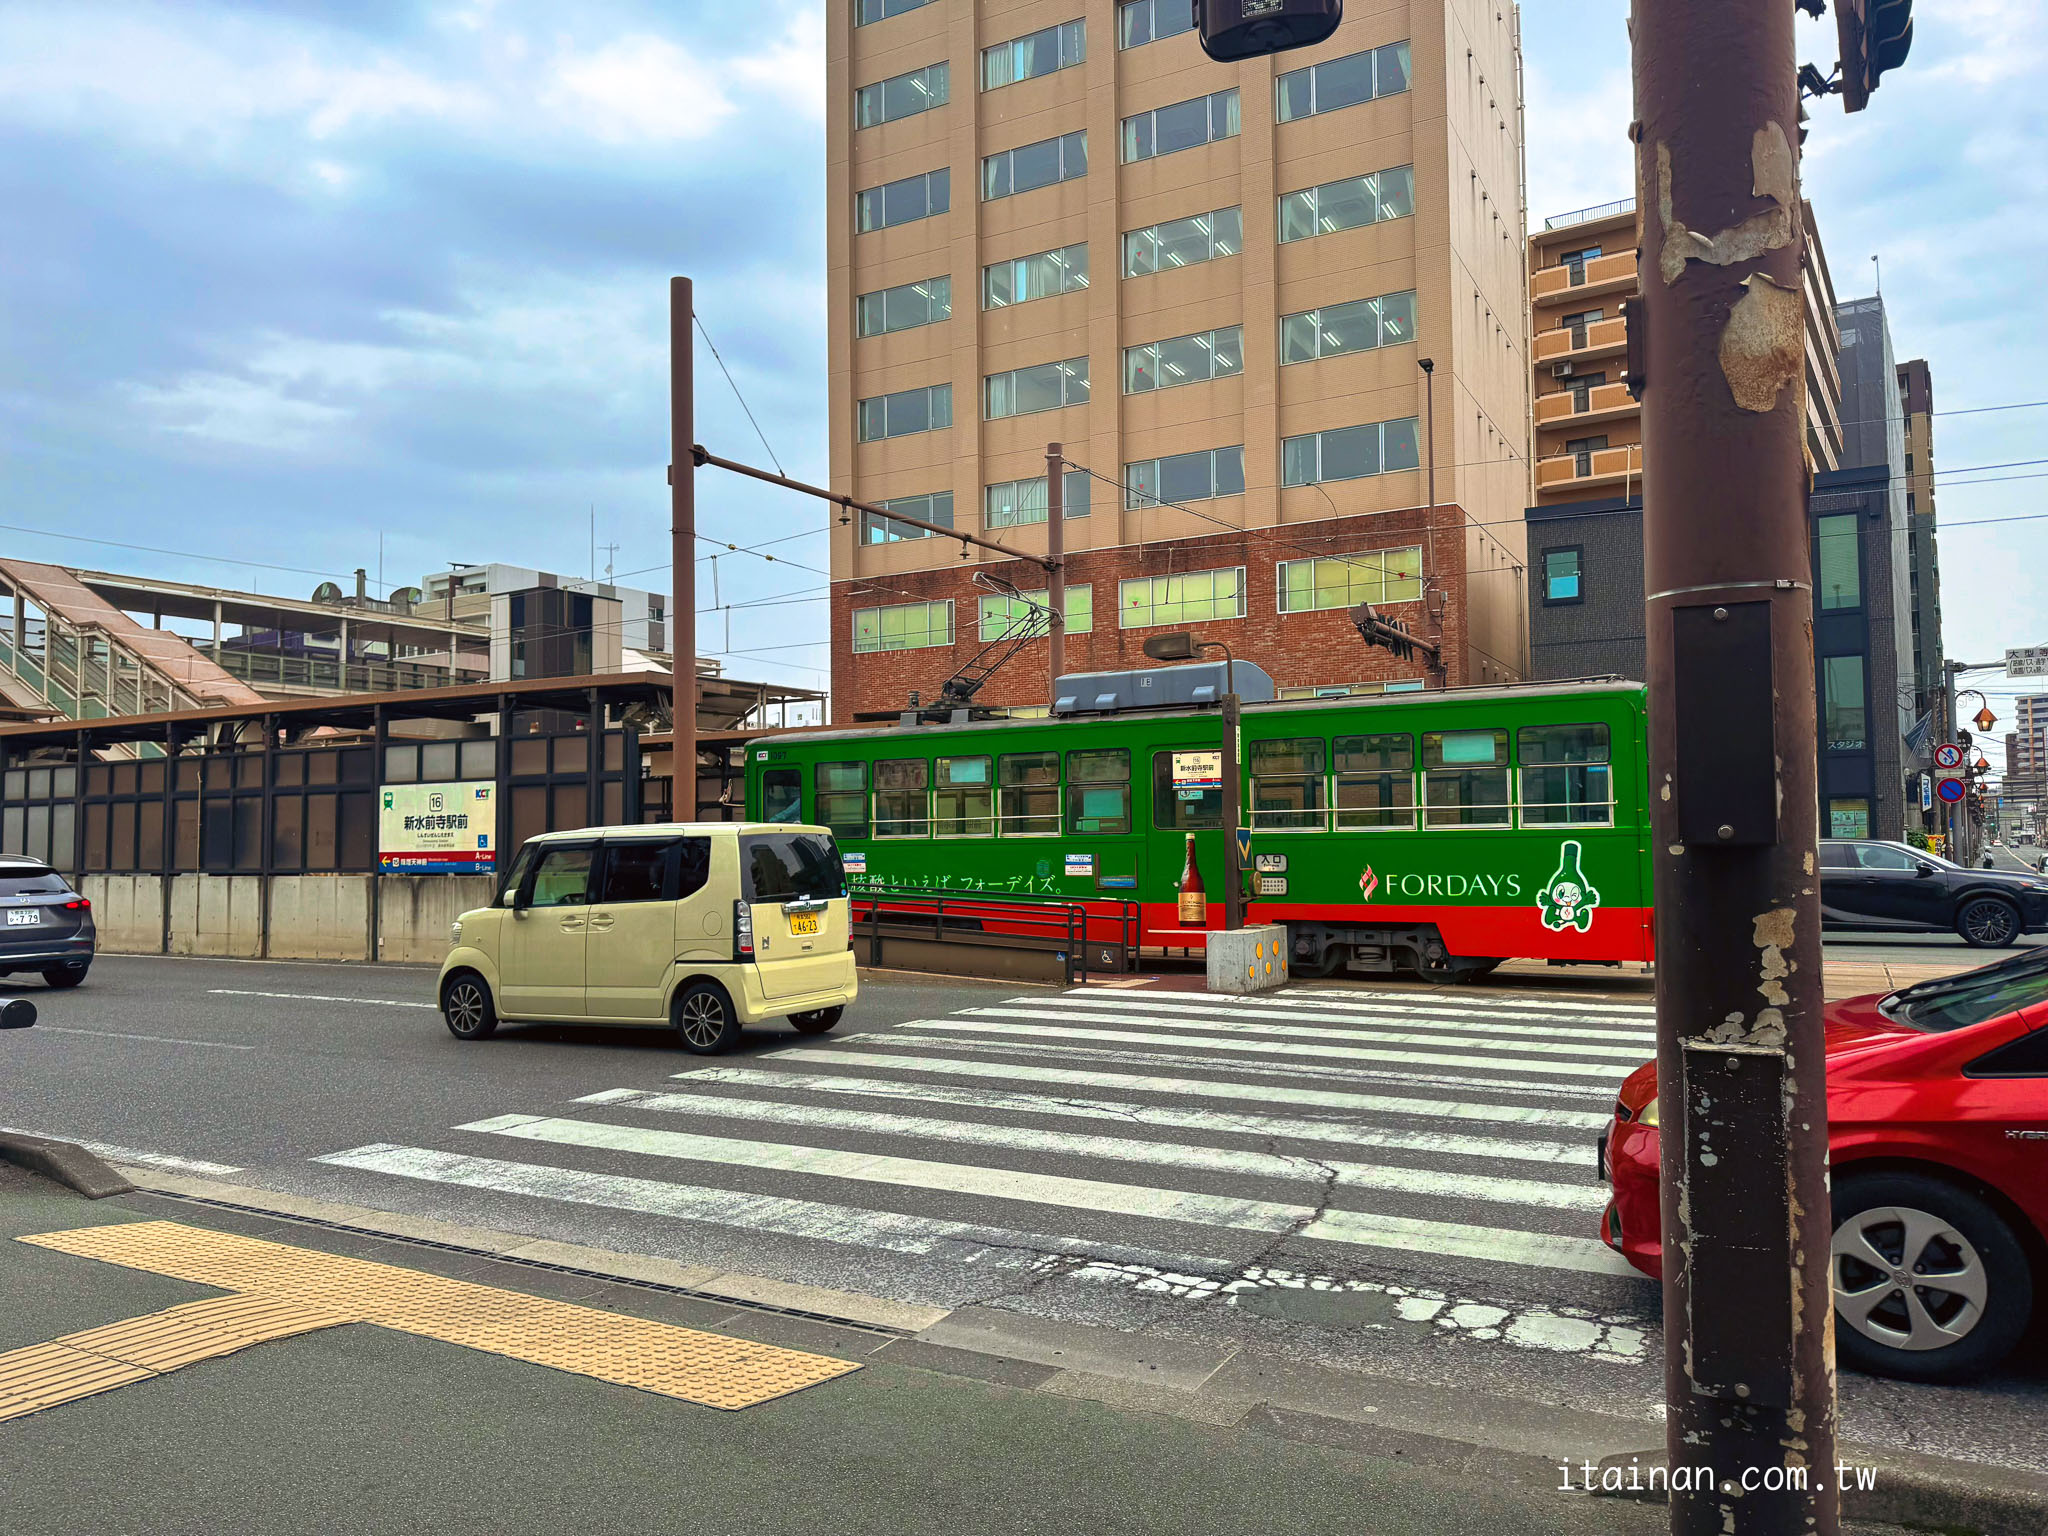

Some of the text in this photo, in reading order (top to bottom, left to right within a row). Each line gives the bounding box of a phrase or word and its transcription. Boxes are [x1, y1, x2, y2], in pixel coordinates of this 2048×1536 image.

[1827, 740, 1865, 750] スタジオ
[475, 789, 490, 799] KCT
[432, 797, 441, 808] 16
[404, 814, 468, 831] 新水前寺駅前
[475, 852, 492, 860] A-Line
[1261, 855, 1281, 864] 入口
[475, 863, 492, 871] B-Line
[1386, 874, 1521, 896] FORDAYS
